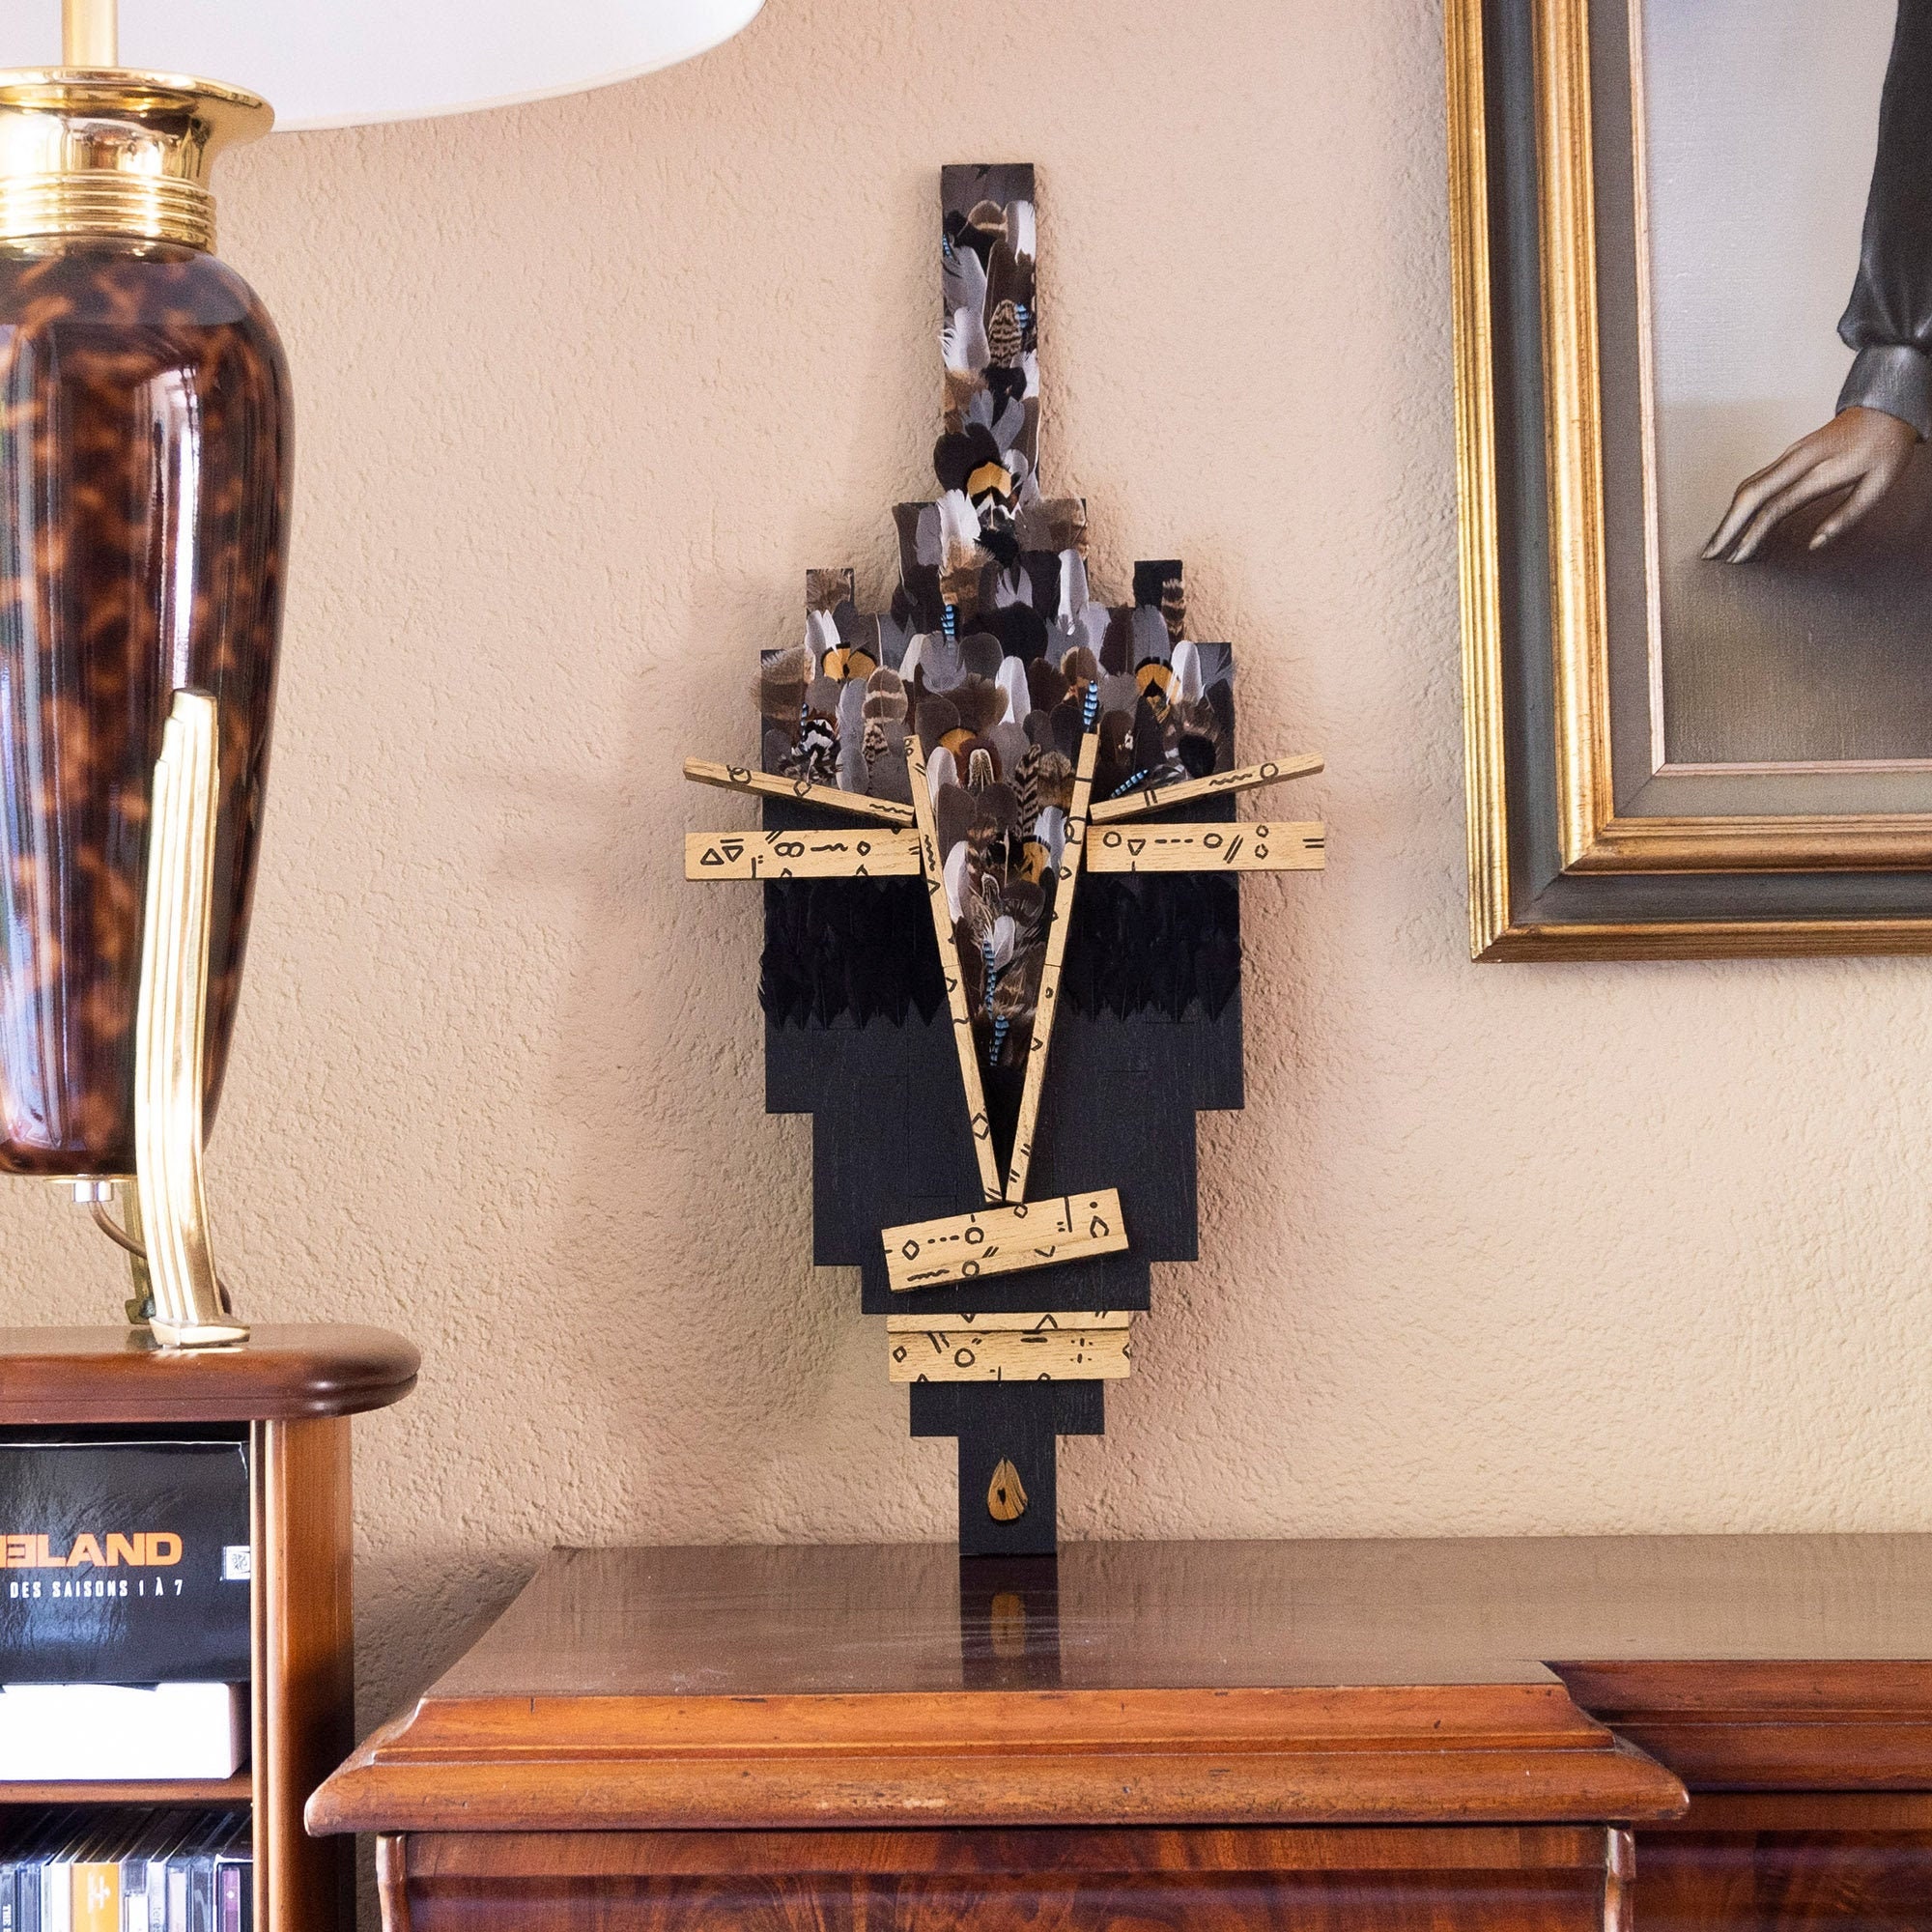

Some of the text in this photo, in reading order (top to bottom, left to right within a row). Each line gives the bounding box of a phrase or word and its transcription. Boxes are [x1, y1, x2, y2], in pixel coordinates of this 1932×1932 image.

[10, 1581, 42, 1599] DES
[52, 1579, 128, 1598] SAISONS
[155, 1577, 164, 1597] À
[174, 1579, 184, 1596] 7
